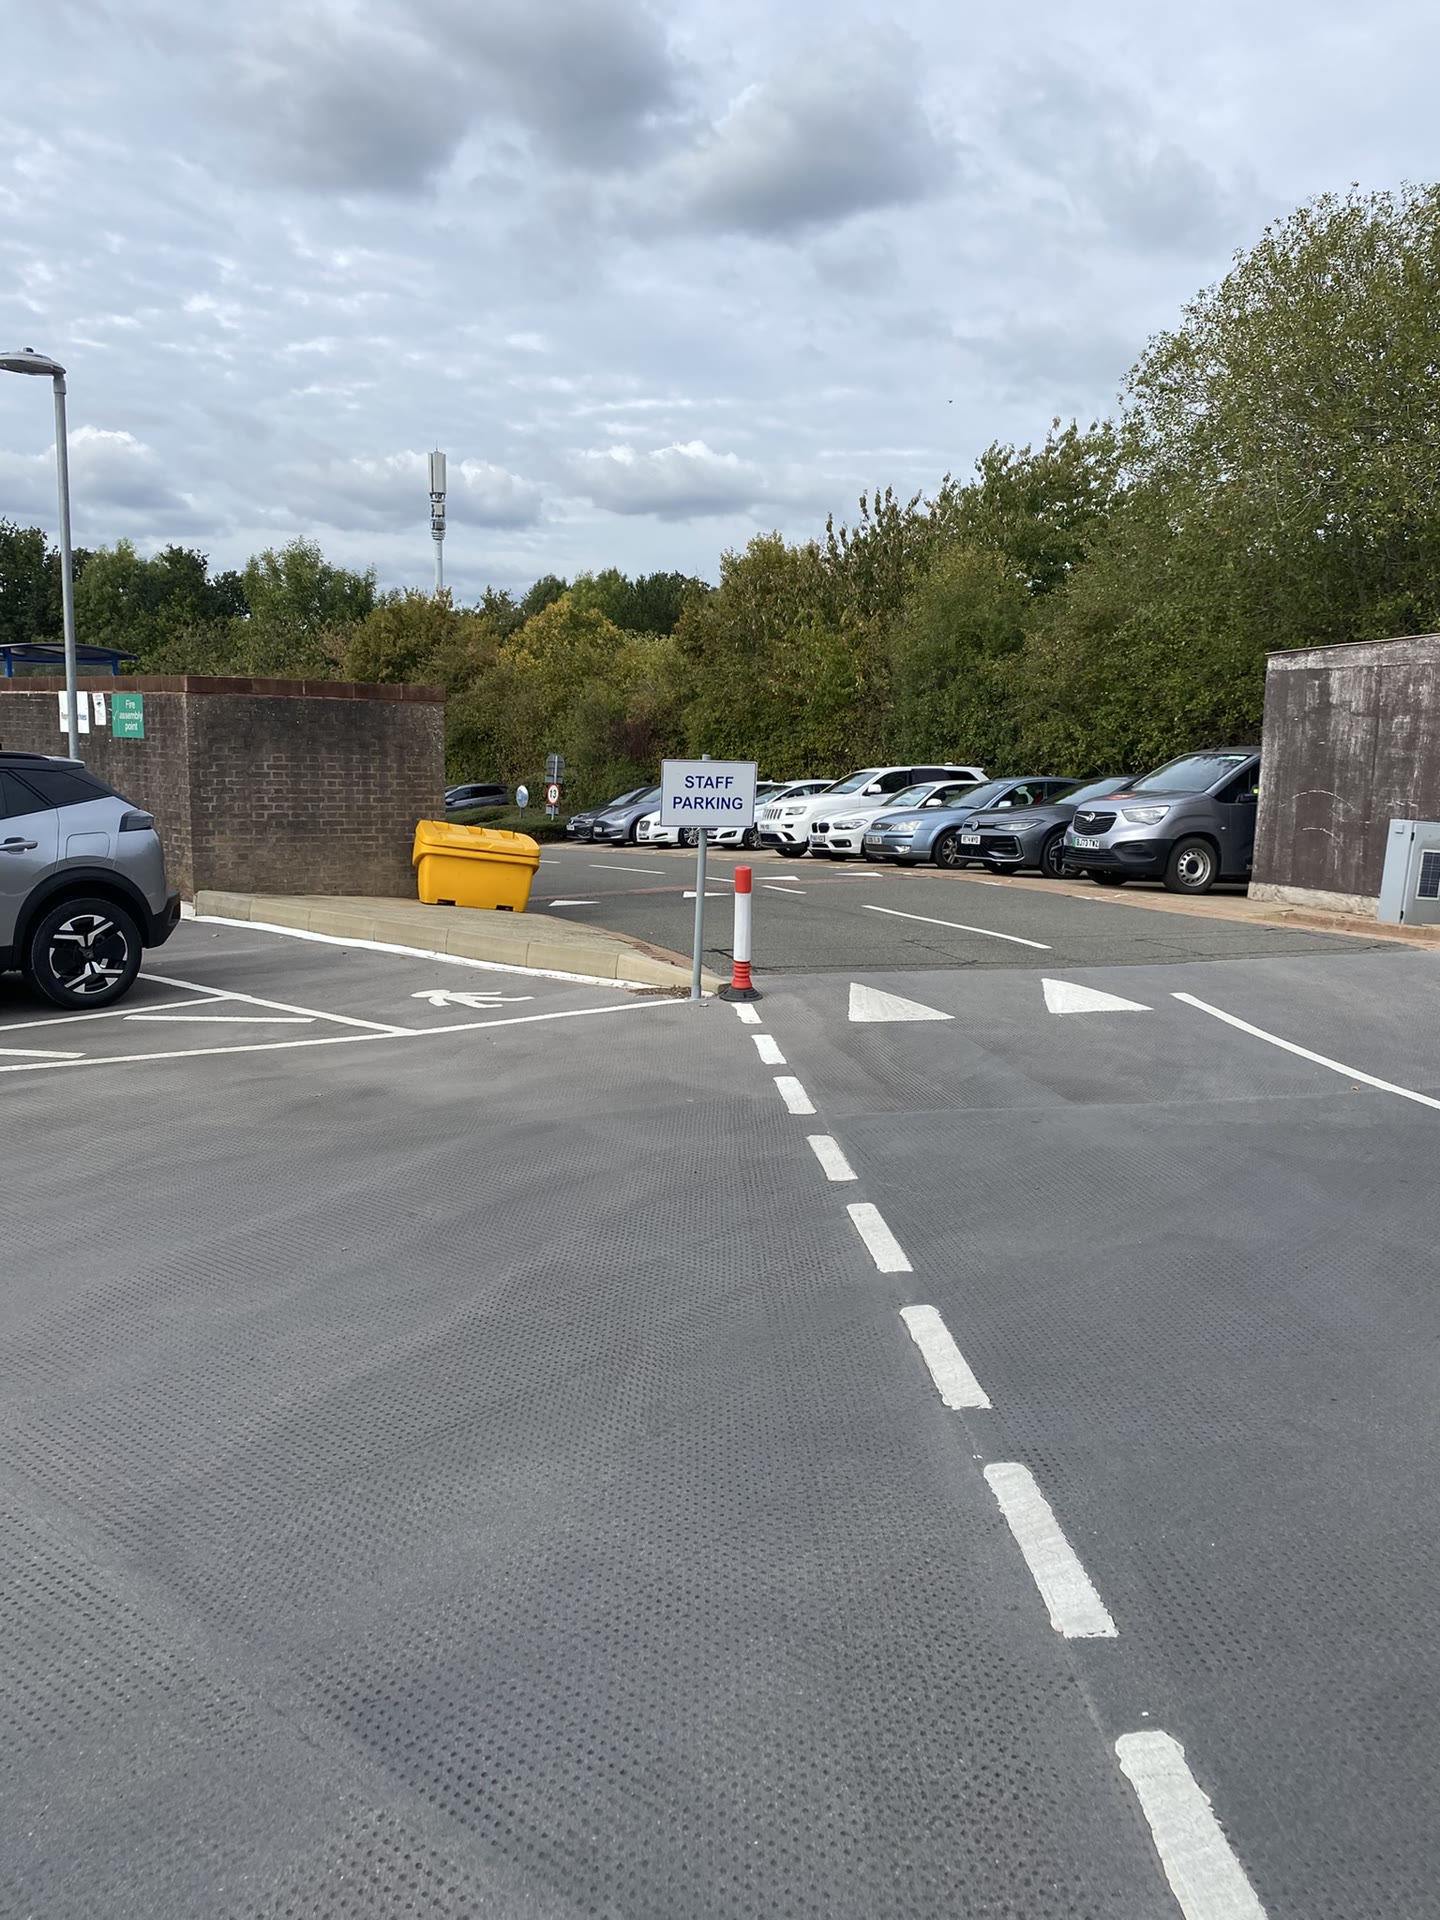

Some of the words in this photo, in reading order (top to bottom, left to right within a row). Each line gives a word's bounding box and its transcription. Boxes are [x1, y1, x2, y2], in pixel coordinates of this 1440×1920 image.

[125, 699, 136, 709] Fire
[119, 711, 143, 722] assembly
[125, 722, 138, 732] point
[684, 776, 734, 788] STAFF
[672, 796, 743, 810] PARKING
